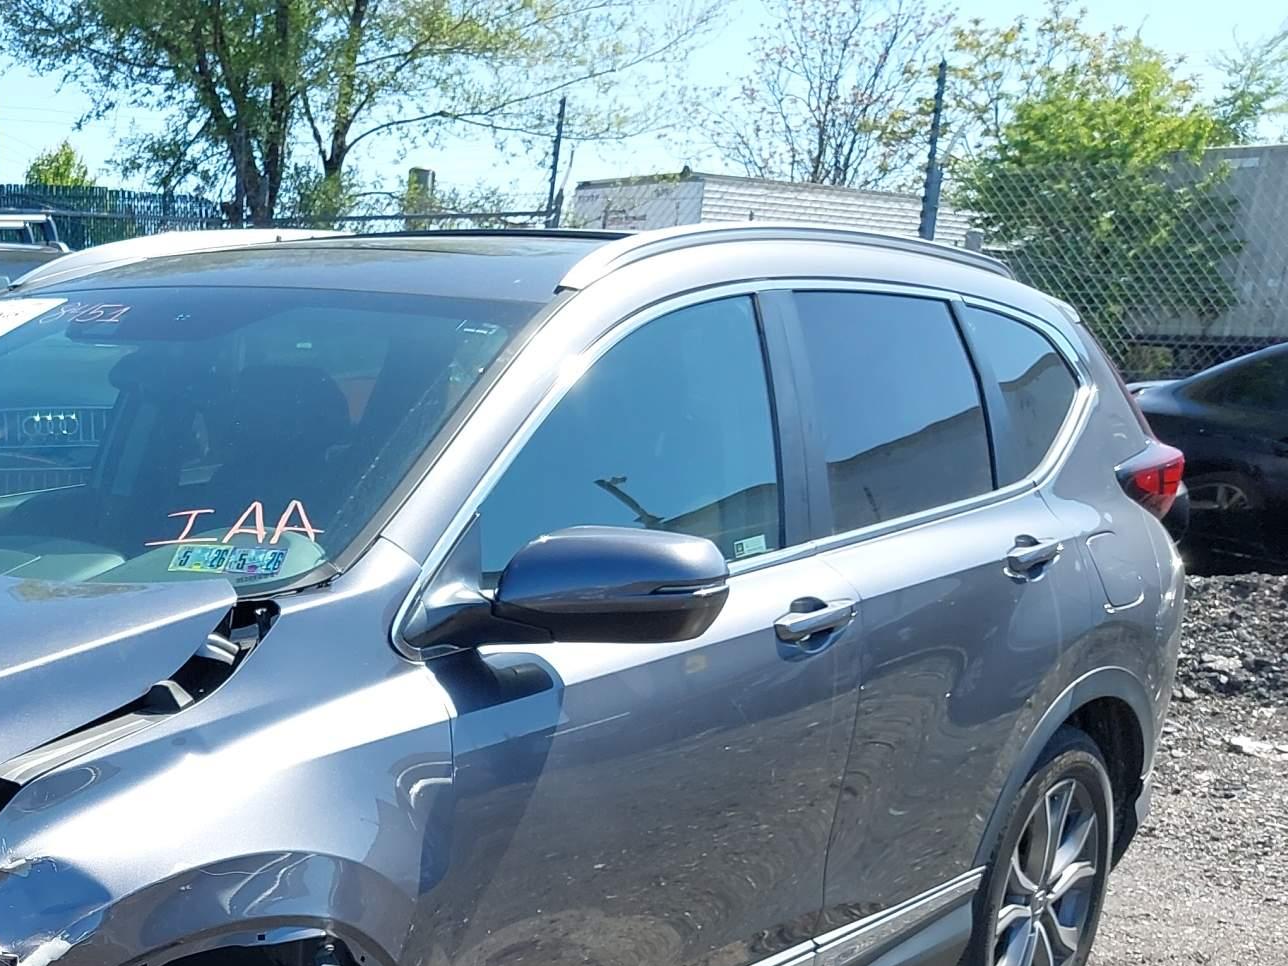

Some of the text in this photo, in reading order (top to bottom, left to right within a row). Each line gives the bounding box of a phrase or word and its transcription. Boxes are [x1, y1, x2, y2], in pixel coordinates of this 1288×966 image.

[144, 499, 325, 546] IAA
[178, 549, 228, 567] 5 26
[236, 551, 284, 570] 5 26
